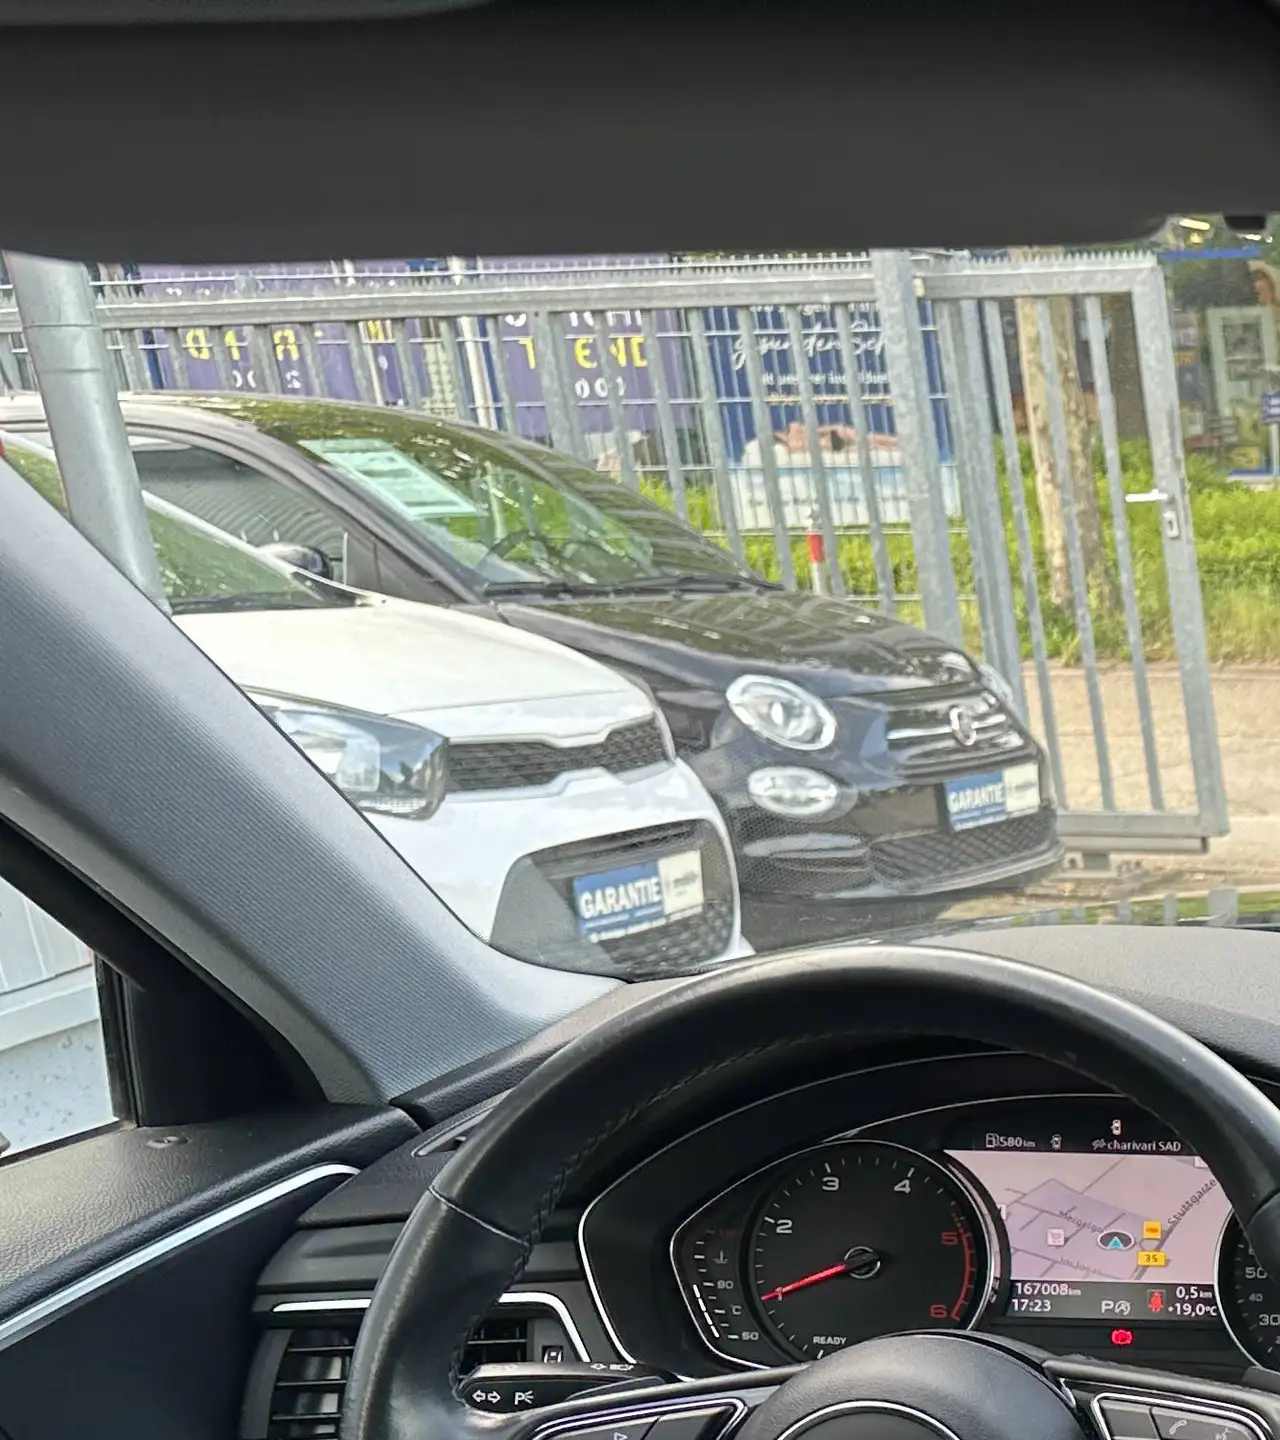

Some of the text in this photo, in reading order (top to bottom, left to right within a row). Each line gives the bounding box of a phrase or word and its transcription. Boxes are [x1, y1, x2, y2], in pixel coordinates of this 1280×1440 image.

[948, 782, 1006, 814] GARANTIE
[580, 876, 662, 920] GARANTIE
[999, 1136, 1022, 1148] 580
[1158, 1141, 1181, 1151] SAD
[822, 1177, 840, 1192] 3
[894, 1179, 912, 1194] 4
[1167, 1179, 1218, 1225] Stuttgarte
[776, 1218, 793, 1235] 2
[940, 1231, 958, 1246] 5
[1144, 1253, 1159, 1264] 35
[1245, 1266, 1268, 1279] 50
[717, 1280, 734, 1291] 90
[1015, 1282, 1068, 1296] 167008
[1176, 1286, 1198, 1300] 0,5
[930, 1304, 948, 1319] 6
[1011, 1298, 1051, 1313] 17:23
[1259, 1313, 1280, 1327] 30
[812, 1335, 847, 1346] READY
